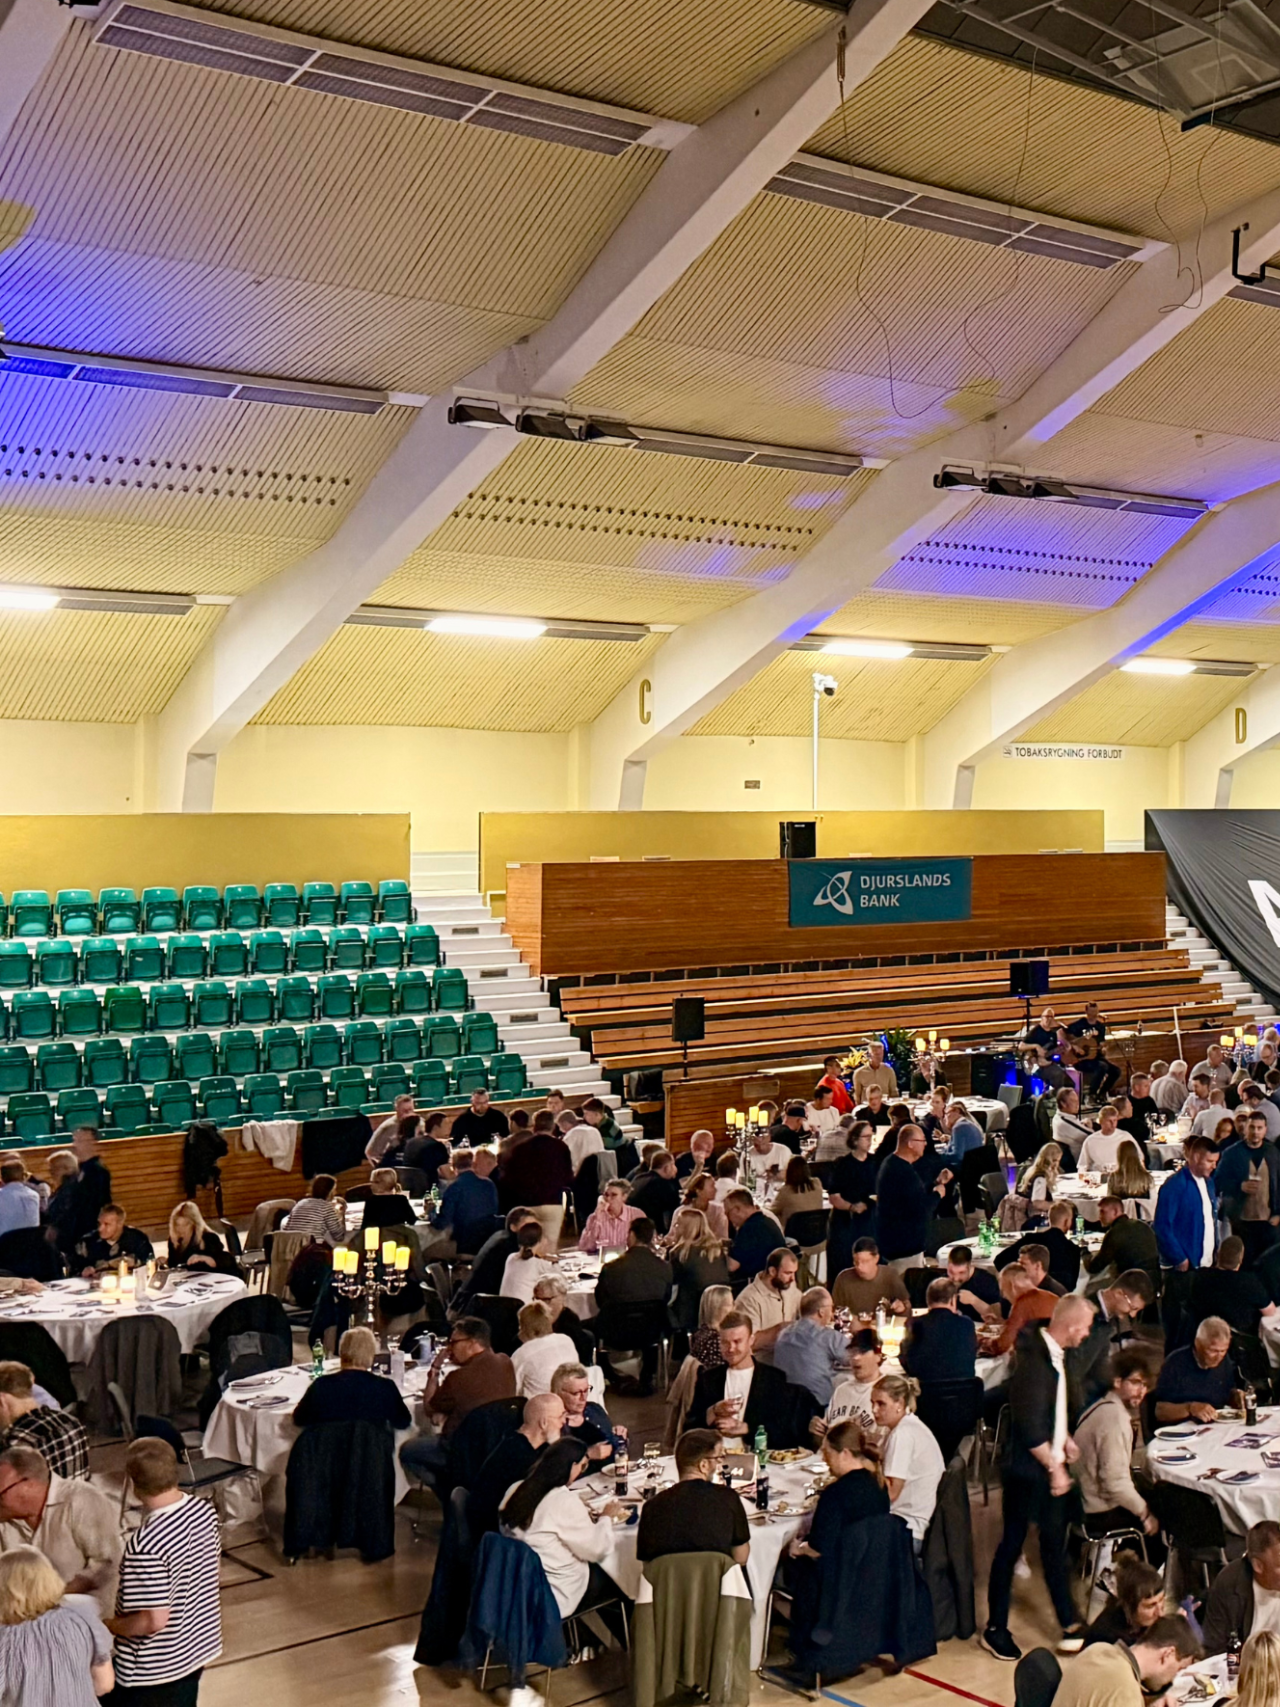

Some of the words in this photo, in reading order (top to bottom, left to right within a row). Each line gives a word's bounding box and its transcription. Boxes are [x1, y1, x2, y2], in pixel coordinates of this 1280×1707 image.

[639, 679, 651, 725] C
[1235, 708, 1247, 744] D
[1015, 747, 1084, 758] TOBAKSRYGNING
[1087, 749, 1122, 759] FORBUDT
[860, 873, 951, 890] DJURSLANDS
[860, 894, 900, 908] BANK
